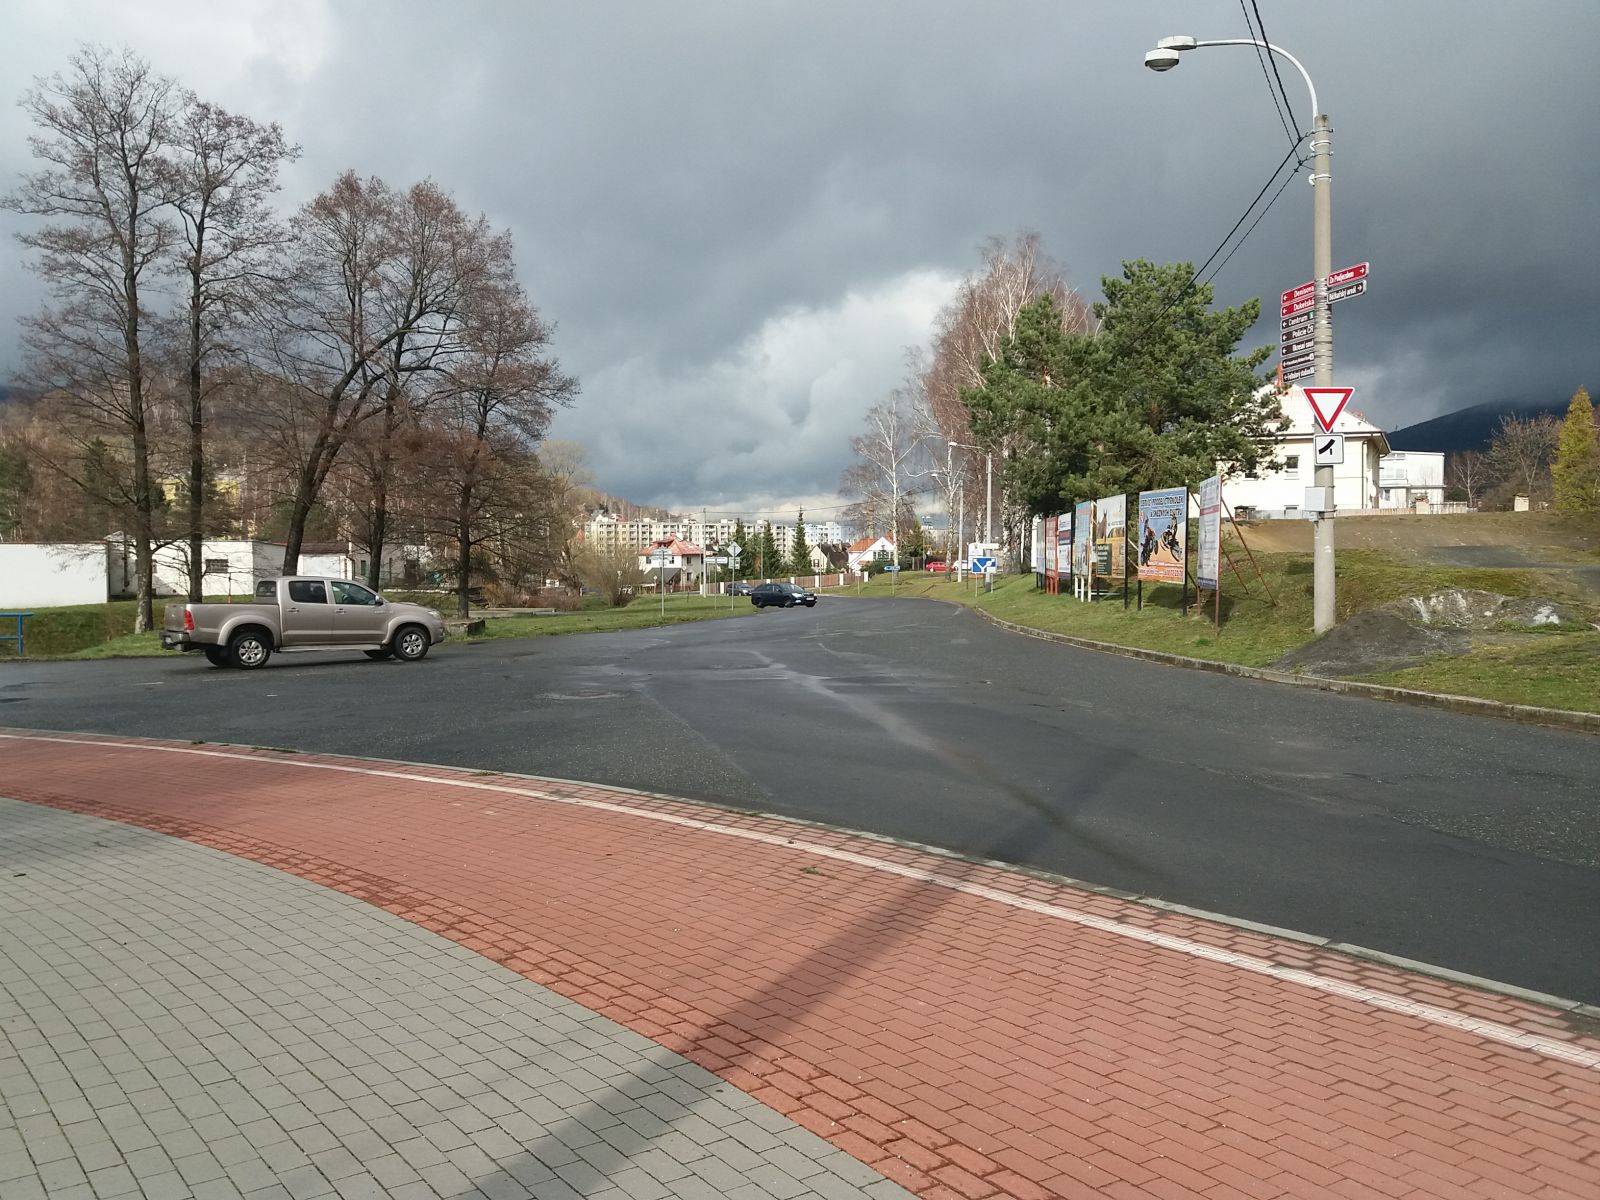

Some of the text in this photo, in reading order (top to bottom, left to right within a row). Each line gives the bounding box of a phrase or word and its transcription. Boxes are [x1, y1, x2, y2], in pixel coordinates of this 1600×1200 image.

[1293, 286, 1315, 298] Denisova
[1288, 314, 1308, 326] Centrum
[1292, 324, 1314, 338] Policie ČR
